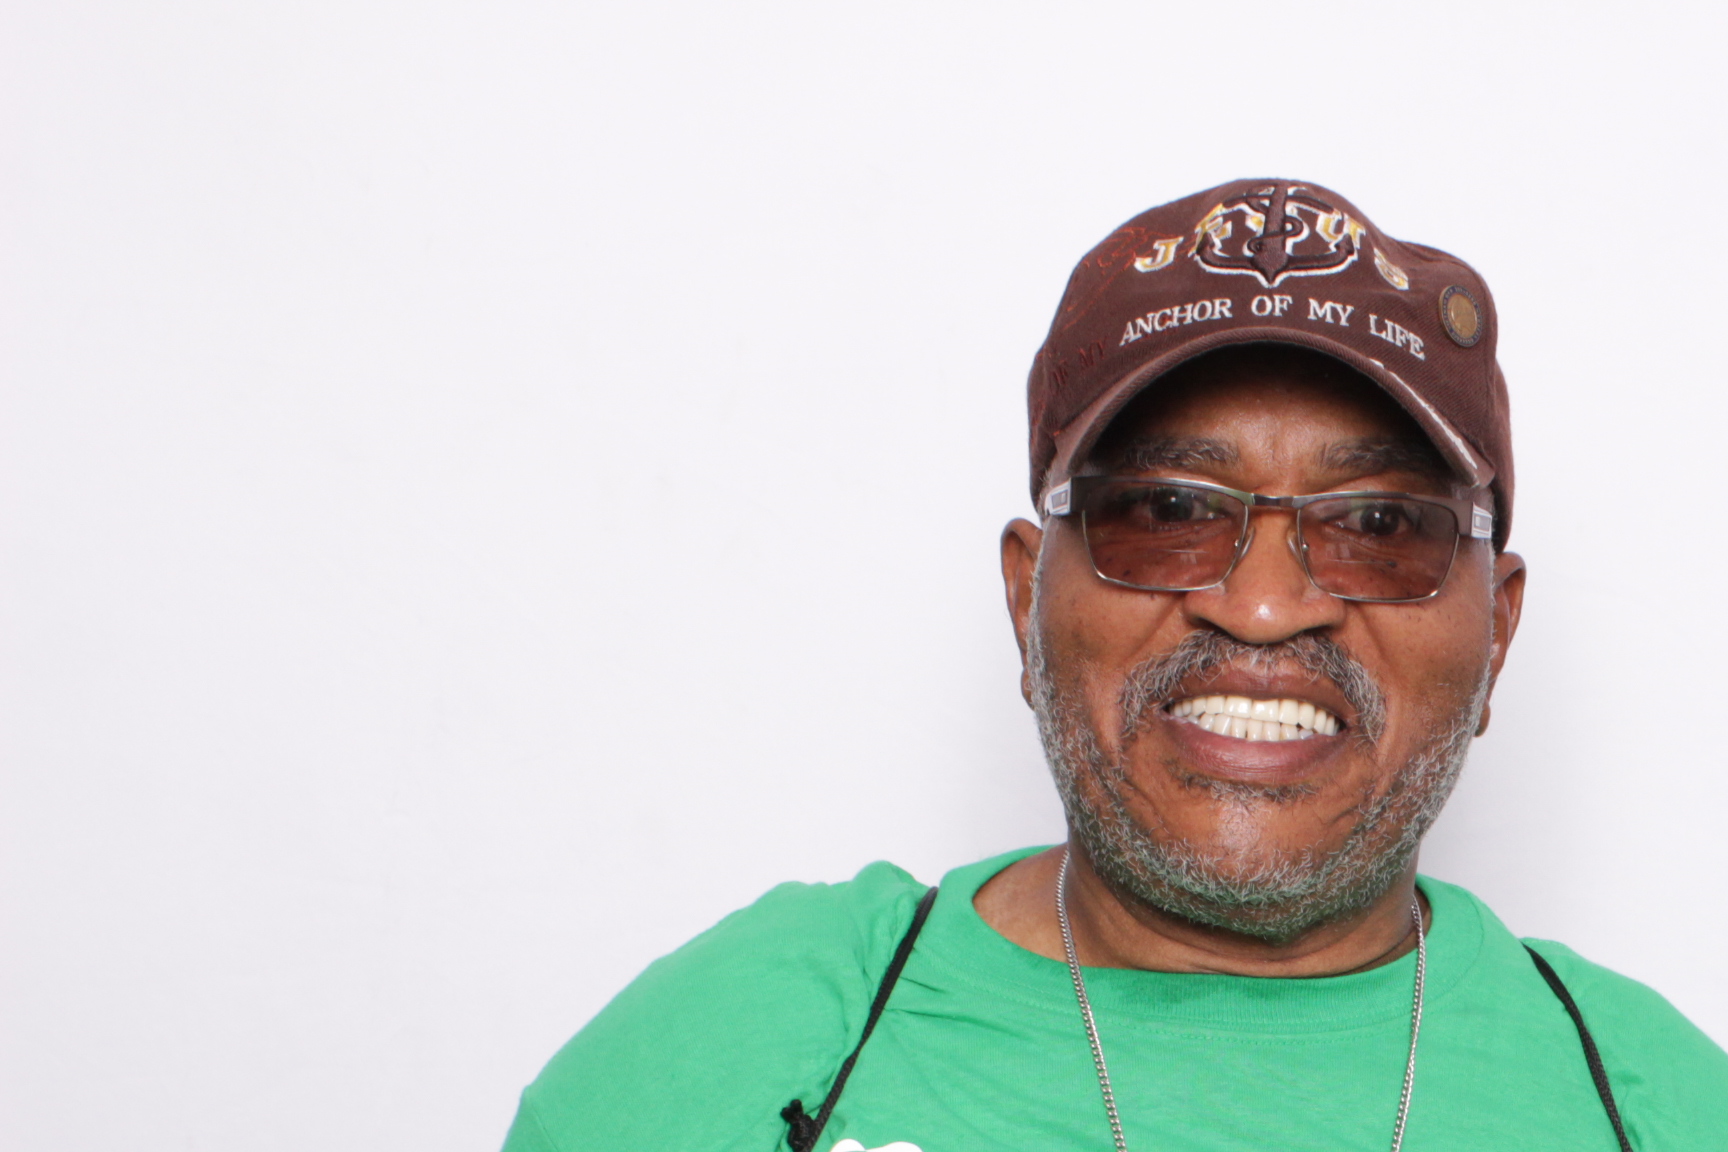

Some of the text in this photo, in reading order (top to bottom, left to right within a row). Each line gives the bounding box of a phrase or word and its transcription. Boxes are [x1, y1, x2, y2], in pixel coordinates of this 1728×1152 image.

[1119, 298, 1233, 346] ANCHOR
[1251, 295, 1292, 316] OF
[1308, 298, 1354, 326] MY
[1369, 314, 1425, 361] LIFE
